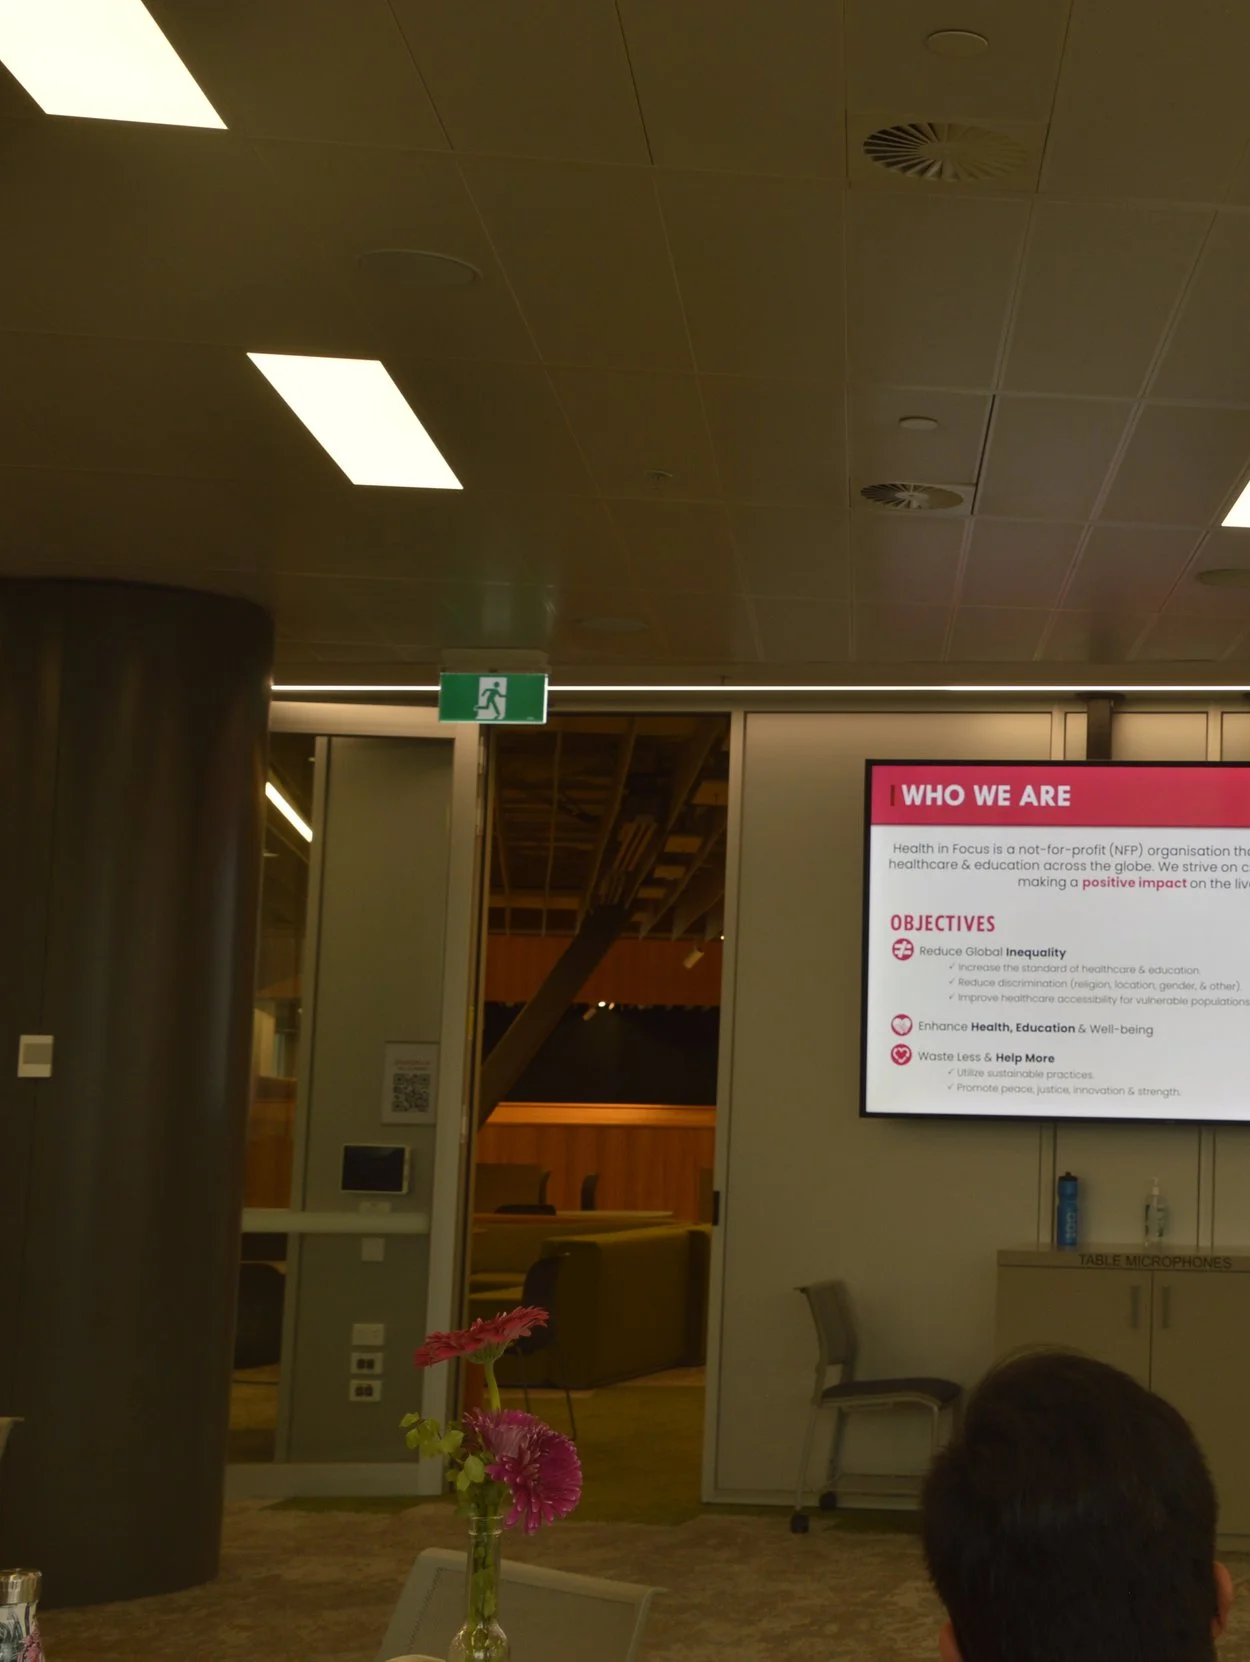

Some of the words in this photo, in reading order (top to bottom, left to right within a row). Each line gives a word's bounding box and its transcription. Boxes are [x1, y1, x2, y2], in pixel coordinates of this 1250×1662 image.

[902, 784, 965, 806] WHO
[974, 785, 1010, 806] WE
[1019, 785, 1071, 806] ARE
[894, 843, 934, 854] Health
[938, 844, 949, 854] in
[953, 844, 989, 855] Focus
[993, 844, 1002, 855] is
[1007, 847, 1015, 855] a
[1019, 844, 1105, 858] not-for-profit
[1110, 843, 1143, 858] (NFP)
[1147, 845, 1230, 859] organisation
[889, 859, 958, 870] healthcare
[962, 860, 971, 870] &
[974, 860, 1039, 871] education
[1043, 863, 1086, 872] across
[1090, 861, 1111, 872] the
[1115, 861, 1154, 875] globe.
[1158, 862, 1178, 872] We
[1182, 862, 1217, 873] strive
[1221, 865, 1237, 873] on
[1018, 876, 1066, 891] making
[1070, 879, 1078, 888] a
[1082, 877, 1135, 891] positive
[1139, 877, 1187, 891] impact
[1190, 880, 1206, 888] on
[1210, 878, 1231, 889] the
[891, 914, 995, 932] OBJECTIVES
[920, 946, 962, 956] Reduce
[965, 946, 1002, 956] Global
[1006, 947, 1066, 959] Inequality
[958, 964, 1000, 972] Increase
[1003, 964, 1019, 972] the
[1022, 964, 1066, 972] standard
[1082, 965, 1135, 973] healthcare
[958, 978, 995, 987] Reduce
[998, 979, 1067, 987] discrimination
[1200, 982, 1206, 990] &
[958, 994, 999, 1003] Improve
[1002, 994, 1054, 1003] healthcare
[1136, 997, 1188, 1005] vulnerable
[918, 1021, 968, 1031] Enhance
[971, 1022, 1012, 1033] Health,
[1016, 1023, 1075, 1033] Education
[1078, 1024, 1086, 1033] &
[1090, 1024, 1153, 1037] Well-being
[918, 1052, 953, 1061] Waste
[957, 1052, 981, 1062] Less
[985, 1053, 992, 1062] &
[996, 1053, 1022, 1065] Help
[1025, 1054, 1055, 1063] More
[987, 1069, 1043, 1078] sustainable
[957, 1083, 997, 1093] Promote
[1073, 1086, 1124, 1095] innovation
[1128, 1087, 1135, 1095] &
[1138, 1087, 1181, 1098] strength.
[1079, 1254, 1120, 1266] TABLE
[1125, 1255, 1232, 1269] MICROPHONES
